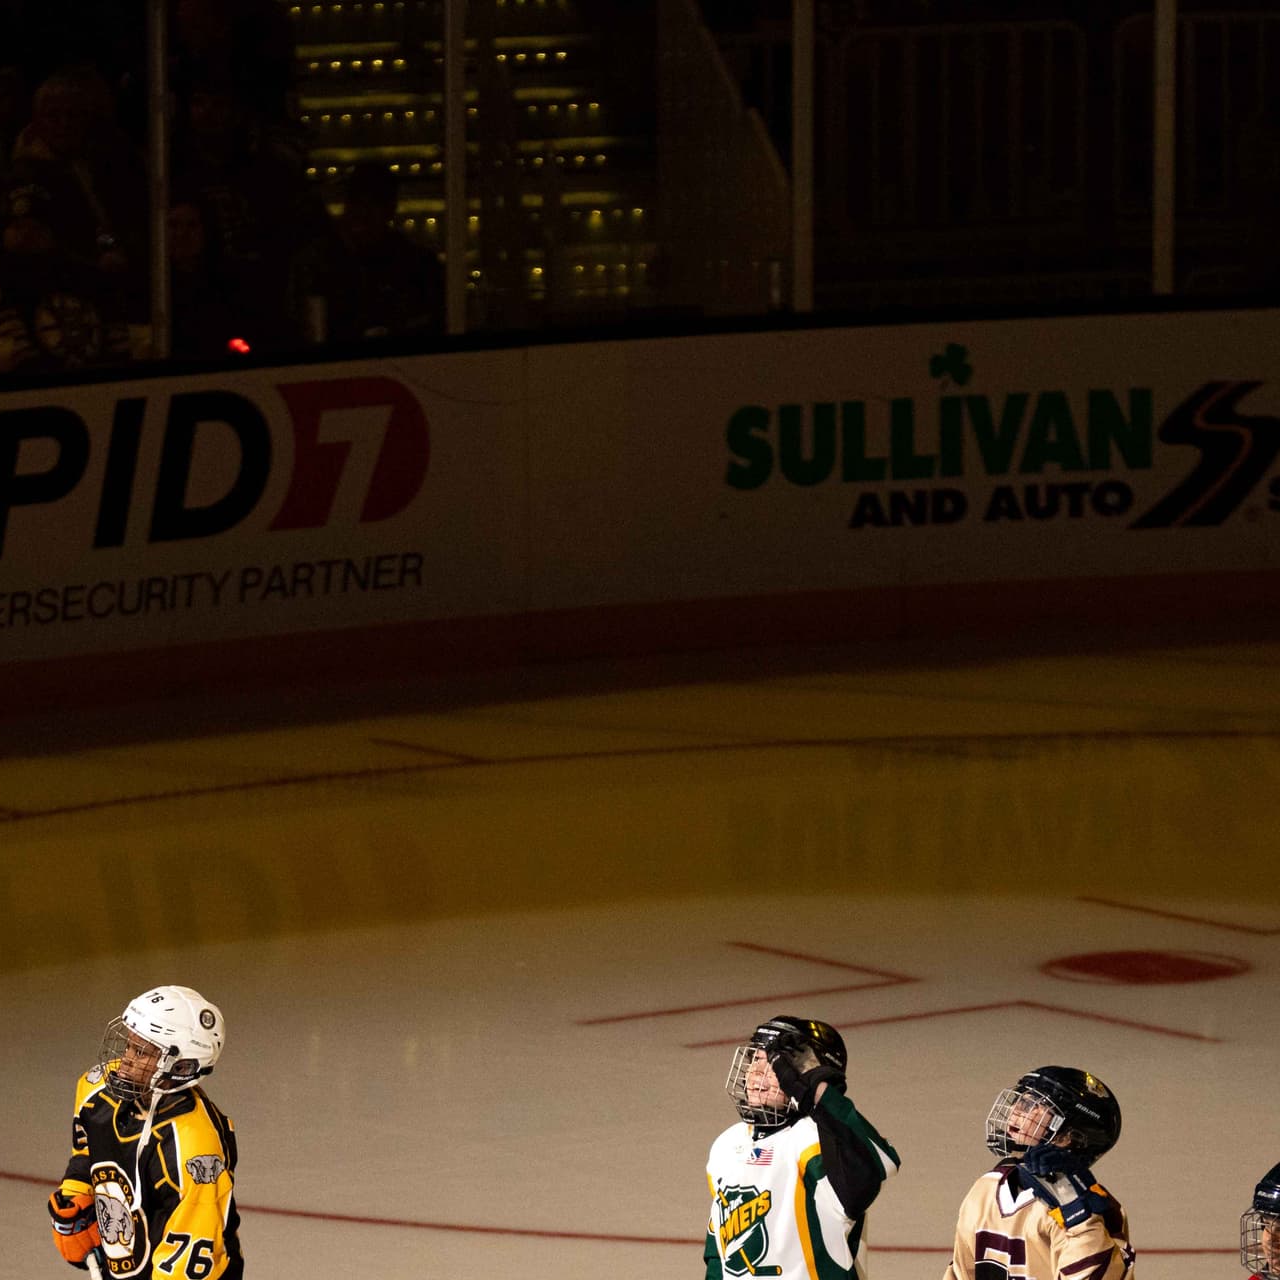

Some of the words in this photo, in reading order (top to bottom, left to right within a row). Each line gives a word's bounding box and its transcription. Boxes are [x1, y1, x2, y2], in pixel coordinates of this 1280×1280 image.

[725, 387, 1153, 490] SULLIVAN
[850, 485, 966, 530] AND
[983, 481, 1134, 522] AUTO
[237, 552, 425, 604] PARTNER
[157, 1230, 216, 1280] 76
